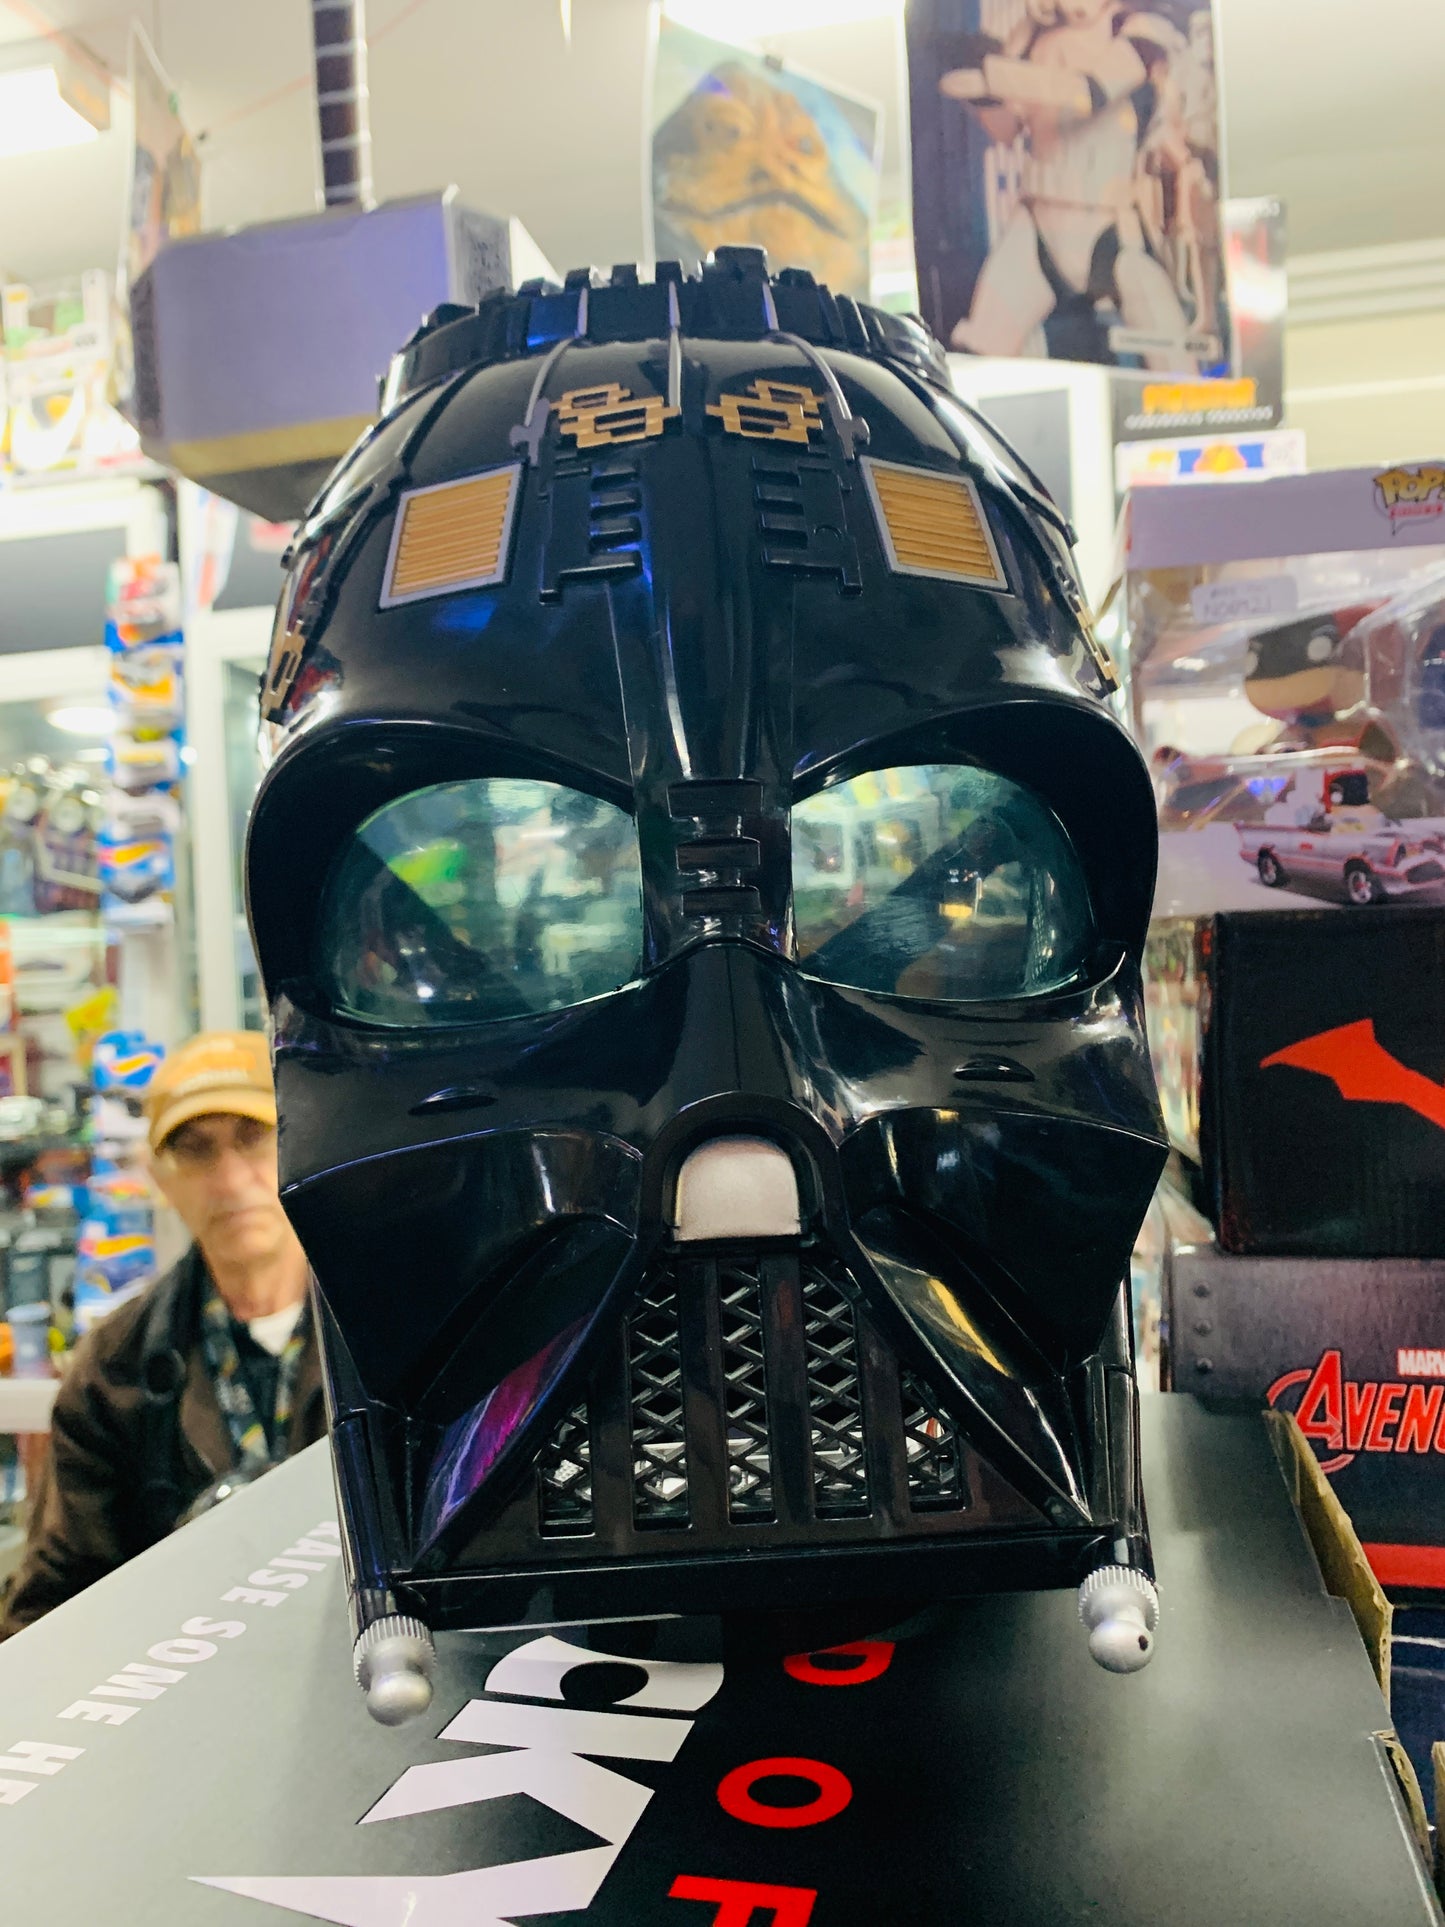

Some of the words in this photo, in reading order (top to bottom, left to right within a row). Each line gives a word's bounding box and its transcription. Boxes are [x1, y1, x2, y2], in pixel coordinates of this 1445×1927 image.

[1295, 1350, 1445, 1454] AVEN
[1397, 1349, 1445, 1376] MAR
[56, 1617, 247, 1726] SOME
[187, 1635, 725, 1927] CKY
